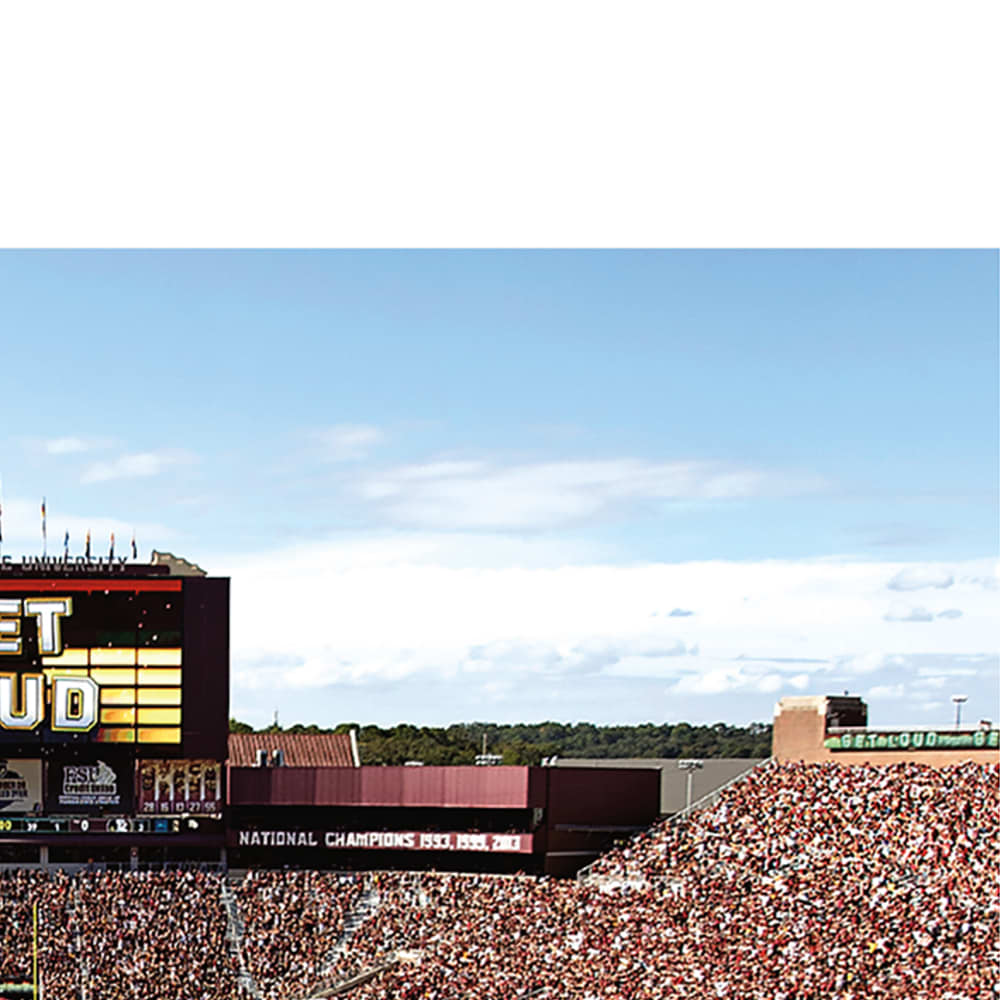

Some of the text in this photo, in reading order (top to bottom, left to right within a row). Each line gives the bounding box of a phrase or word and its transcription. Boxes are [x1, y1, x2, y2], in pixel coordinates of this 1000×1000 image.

[22, 556, 128, 572] UNIVERSITY
[841, 734, 878, 749] GET
[887, 732, 937, 748] LOUD
[239, 831, 318, 847] NATIONAL
[324, 831, 415, 848] CHAMPIONS
